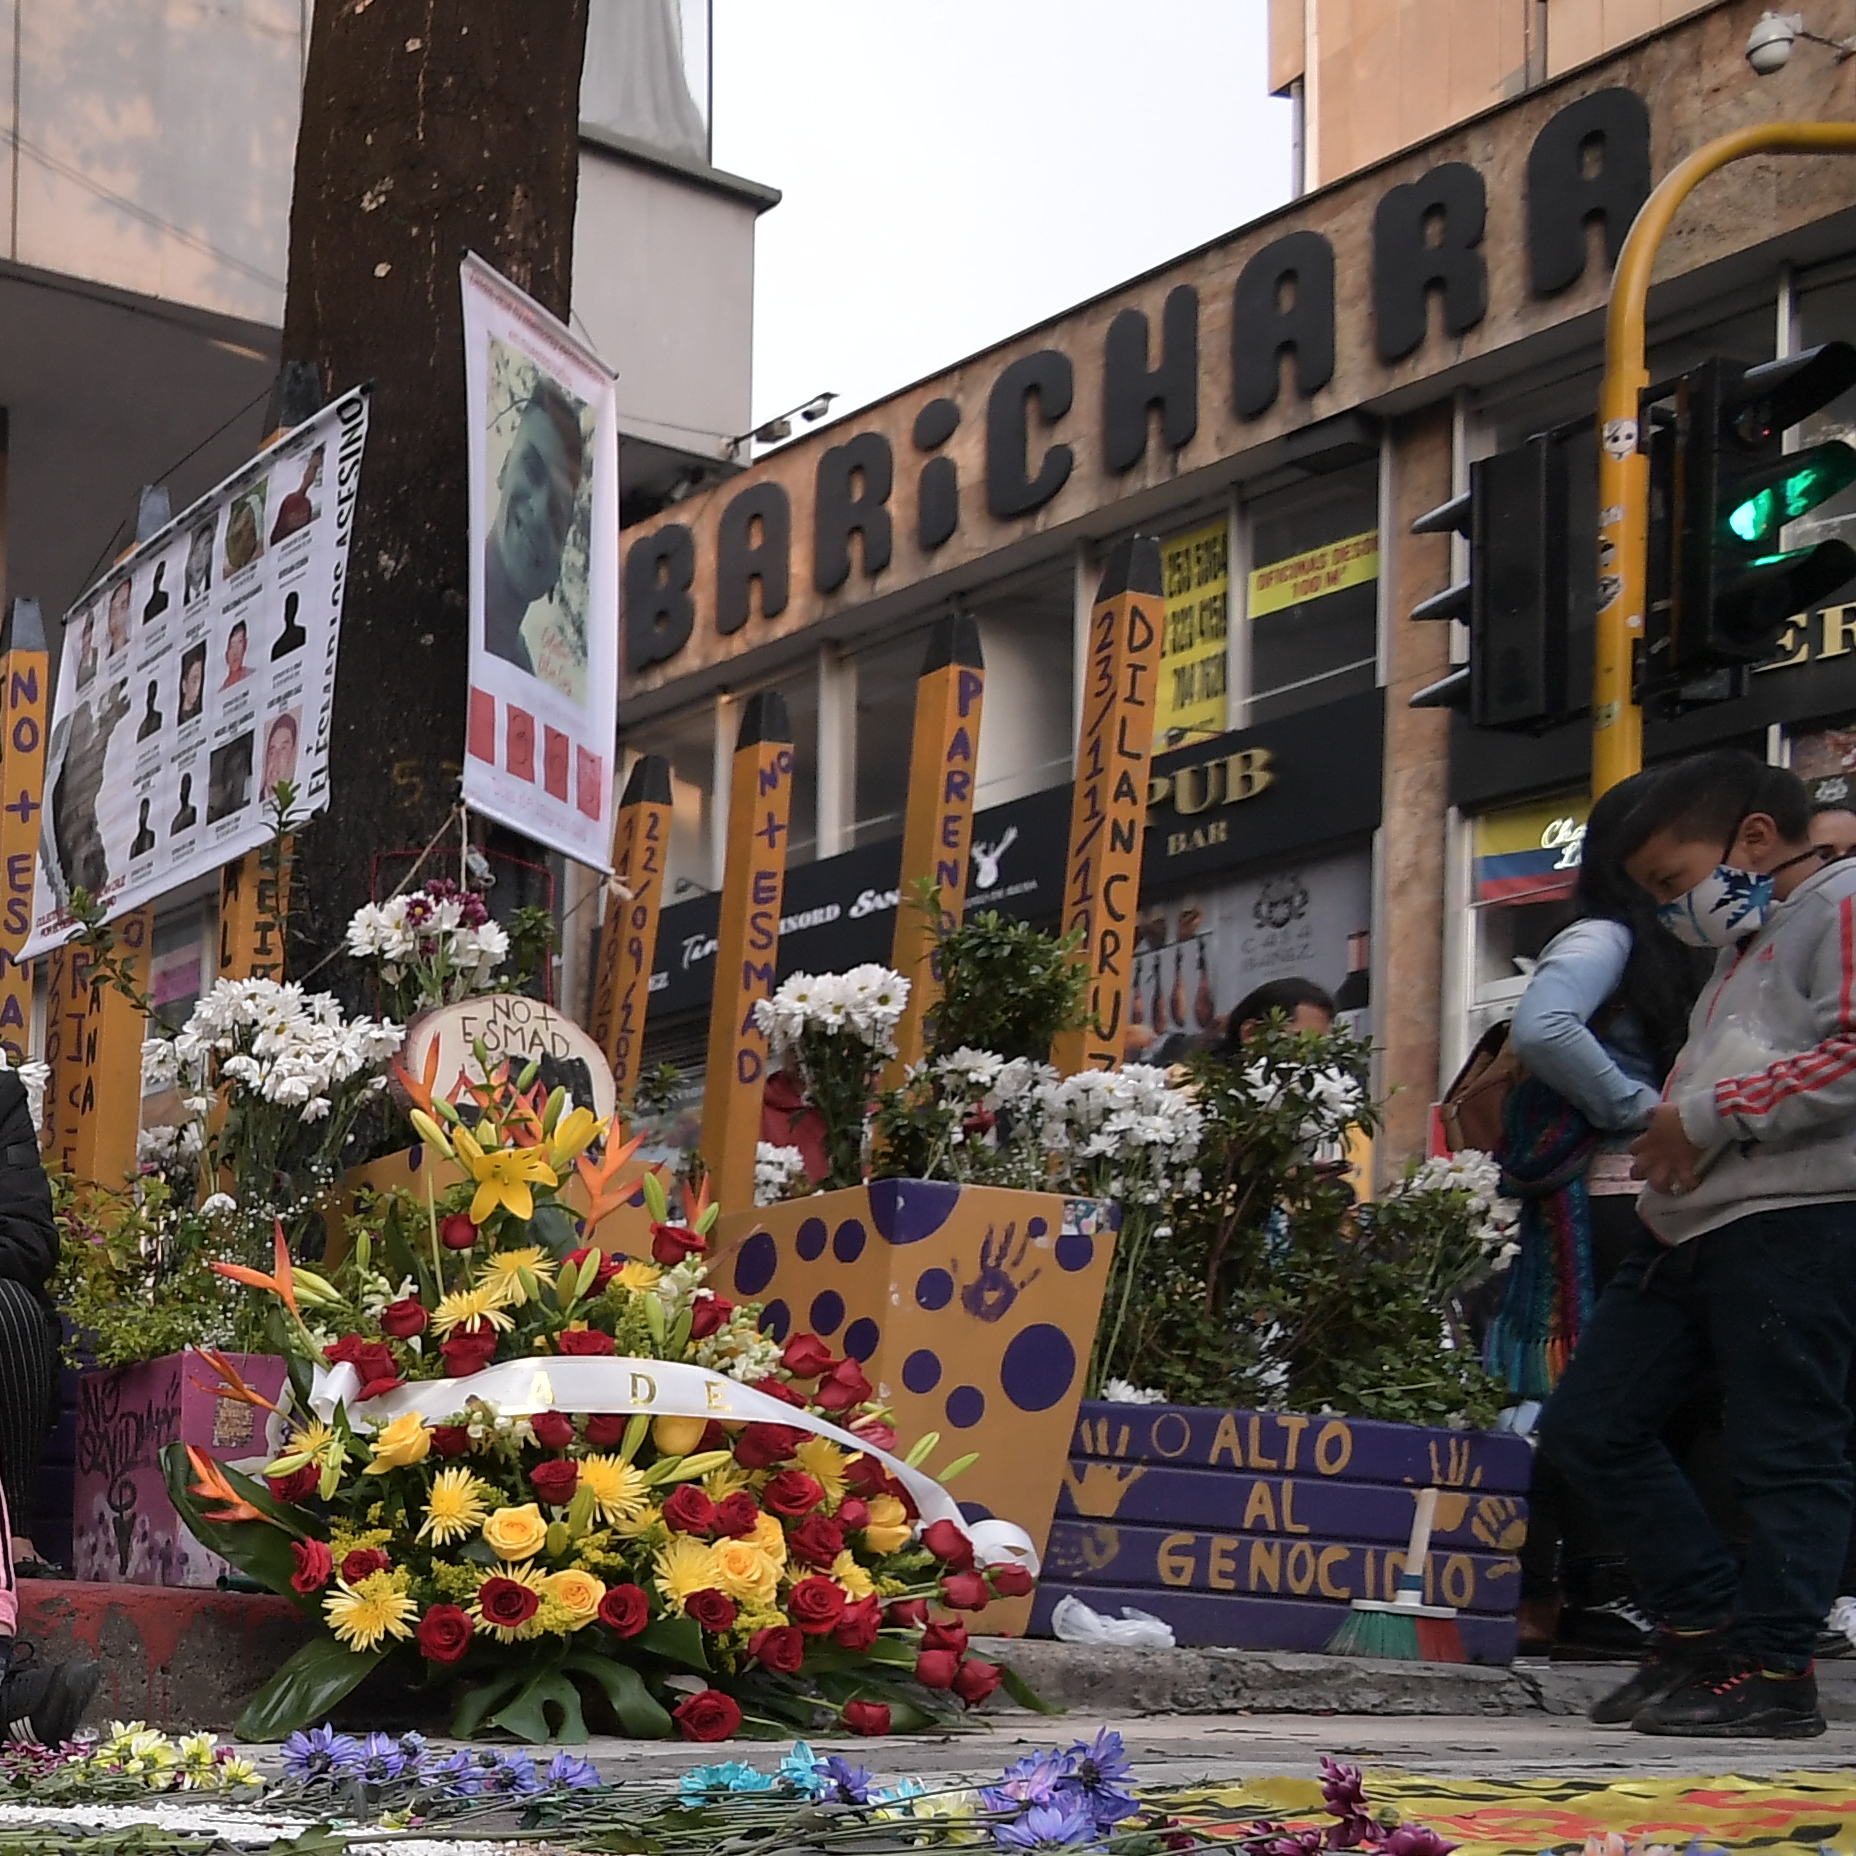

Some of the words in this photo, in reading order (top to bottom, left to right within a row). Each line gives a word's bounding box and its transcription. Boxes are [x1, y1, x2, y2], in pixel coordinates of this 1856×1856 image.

[10, 667, 39, 753] NO
[1108, 604, 1154, 856] DILAN
[757, 750, 794, 798] NO
[1166, 820, 1229, 857] BAR
[460, 1015, 571, 1060] ESMAD
[491, 997, 532, 1024] NO
[1207, 1412, 1354, 1475] ALTO
[1242, 1479, 1311, 1534] AL
[1155, 1532, 1476, 1608] GENOCIDIO
